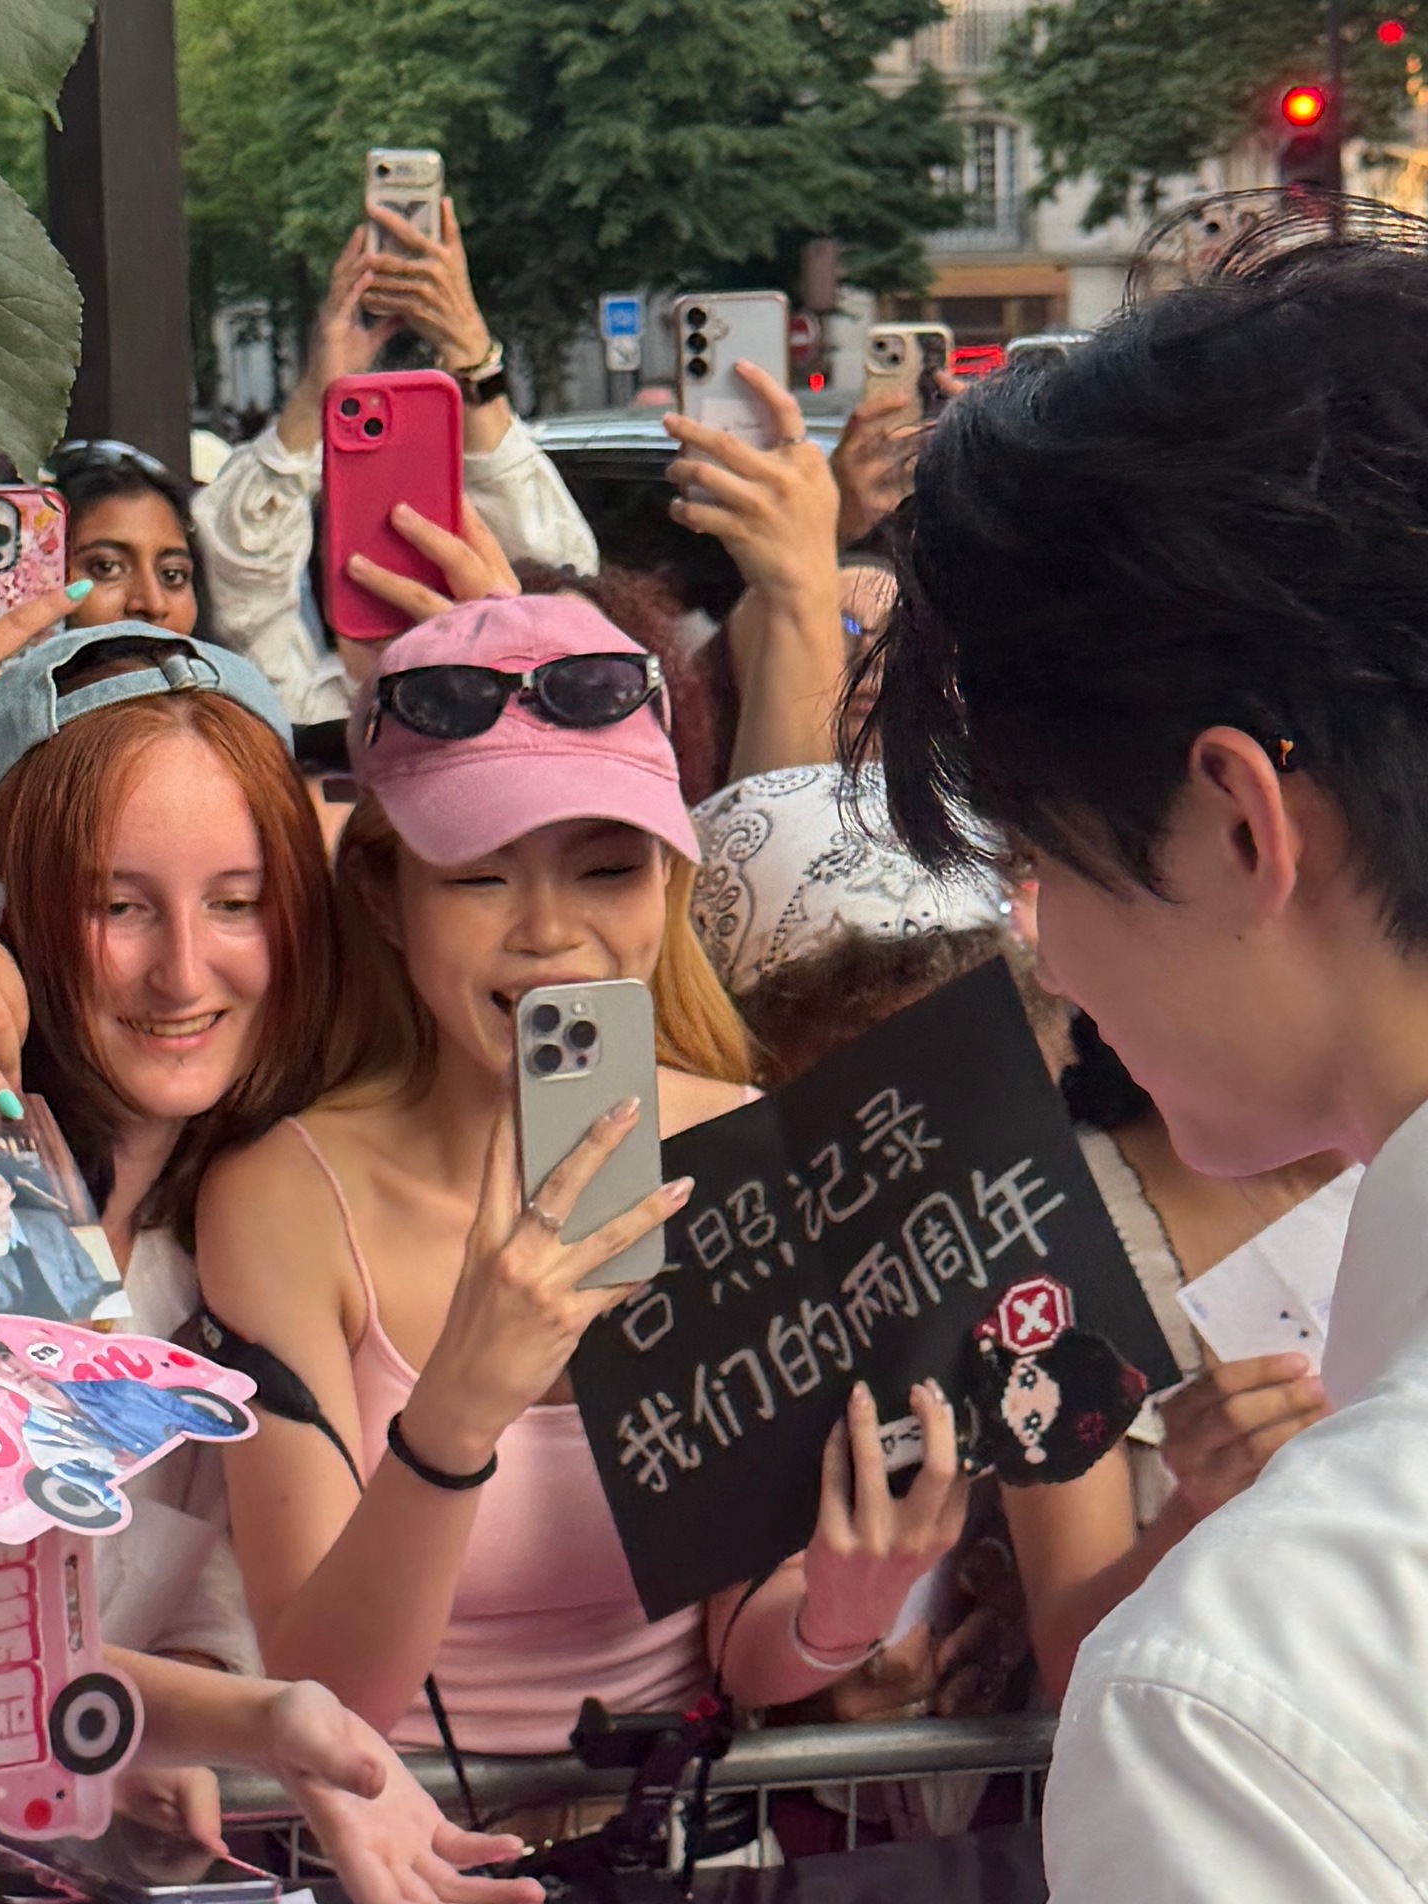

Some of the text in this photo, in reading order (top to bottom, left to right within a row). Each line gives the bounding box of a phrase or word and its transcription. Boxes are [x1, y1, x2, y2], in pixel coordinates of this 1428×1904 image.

[617, 1157, 1066, 1494] 我们的两周年
